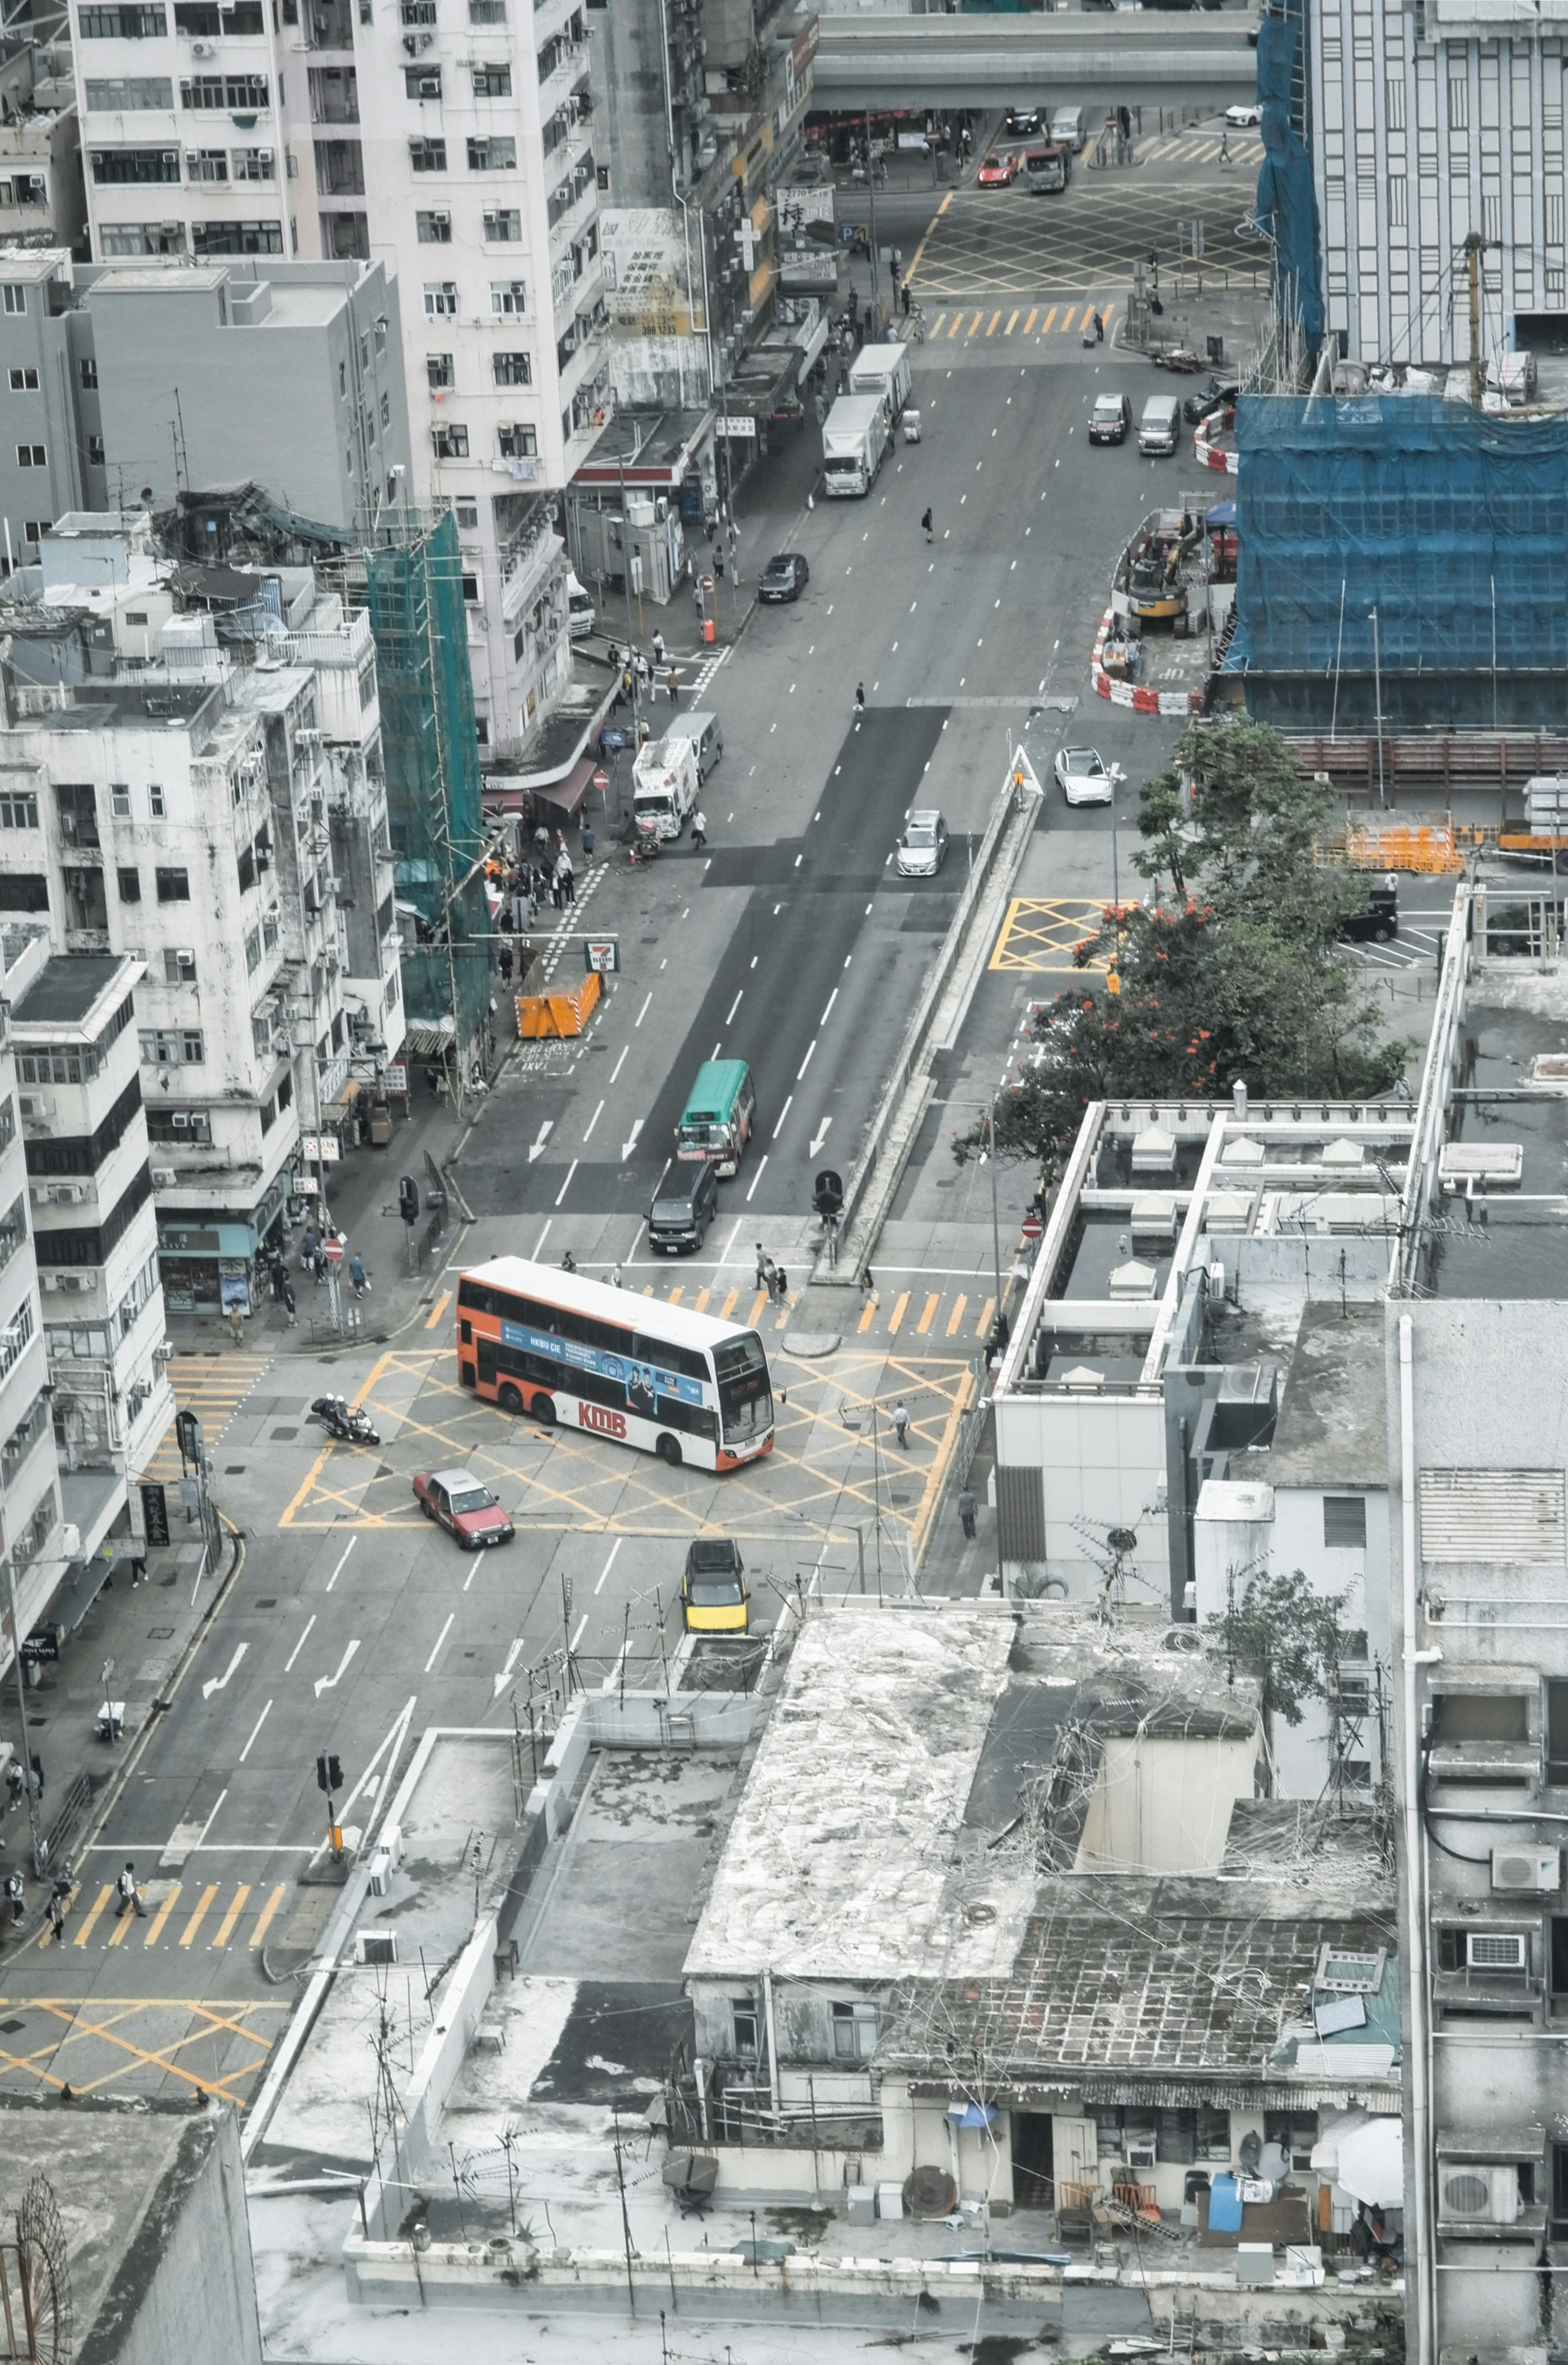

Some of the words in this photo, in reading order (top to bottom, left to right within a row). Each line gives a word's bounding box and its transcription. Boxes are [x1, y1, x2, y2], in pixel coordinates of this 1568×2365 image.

[843, 228, 852, 241] P
[642, 326, 656, 335] 398
[592, 946, 611, 970] 7
[530, 1336, 549, 1350] HKBU
[550, 1343, 561, 1354] CIE
